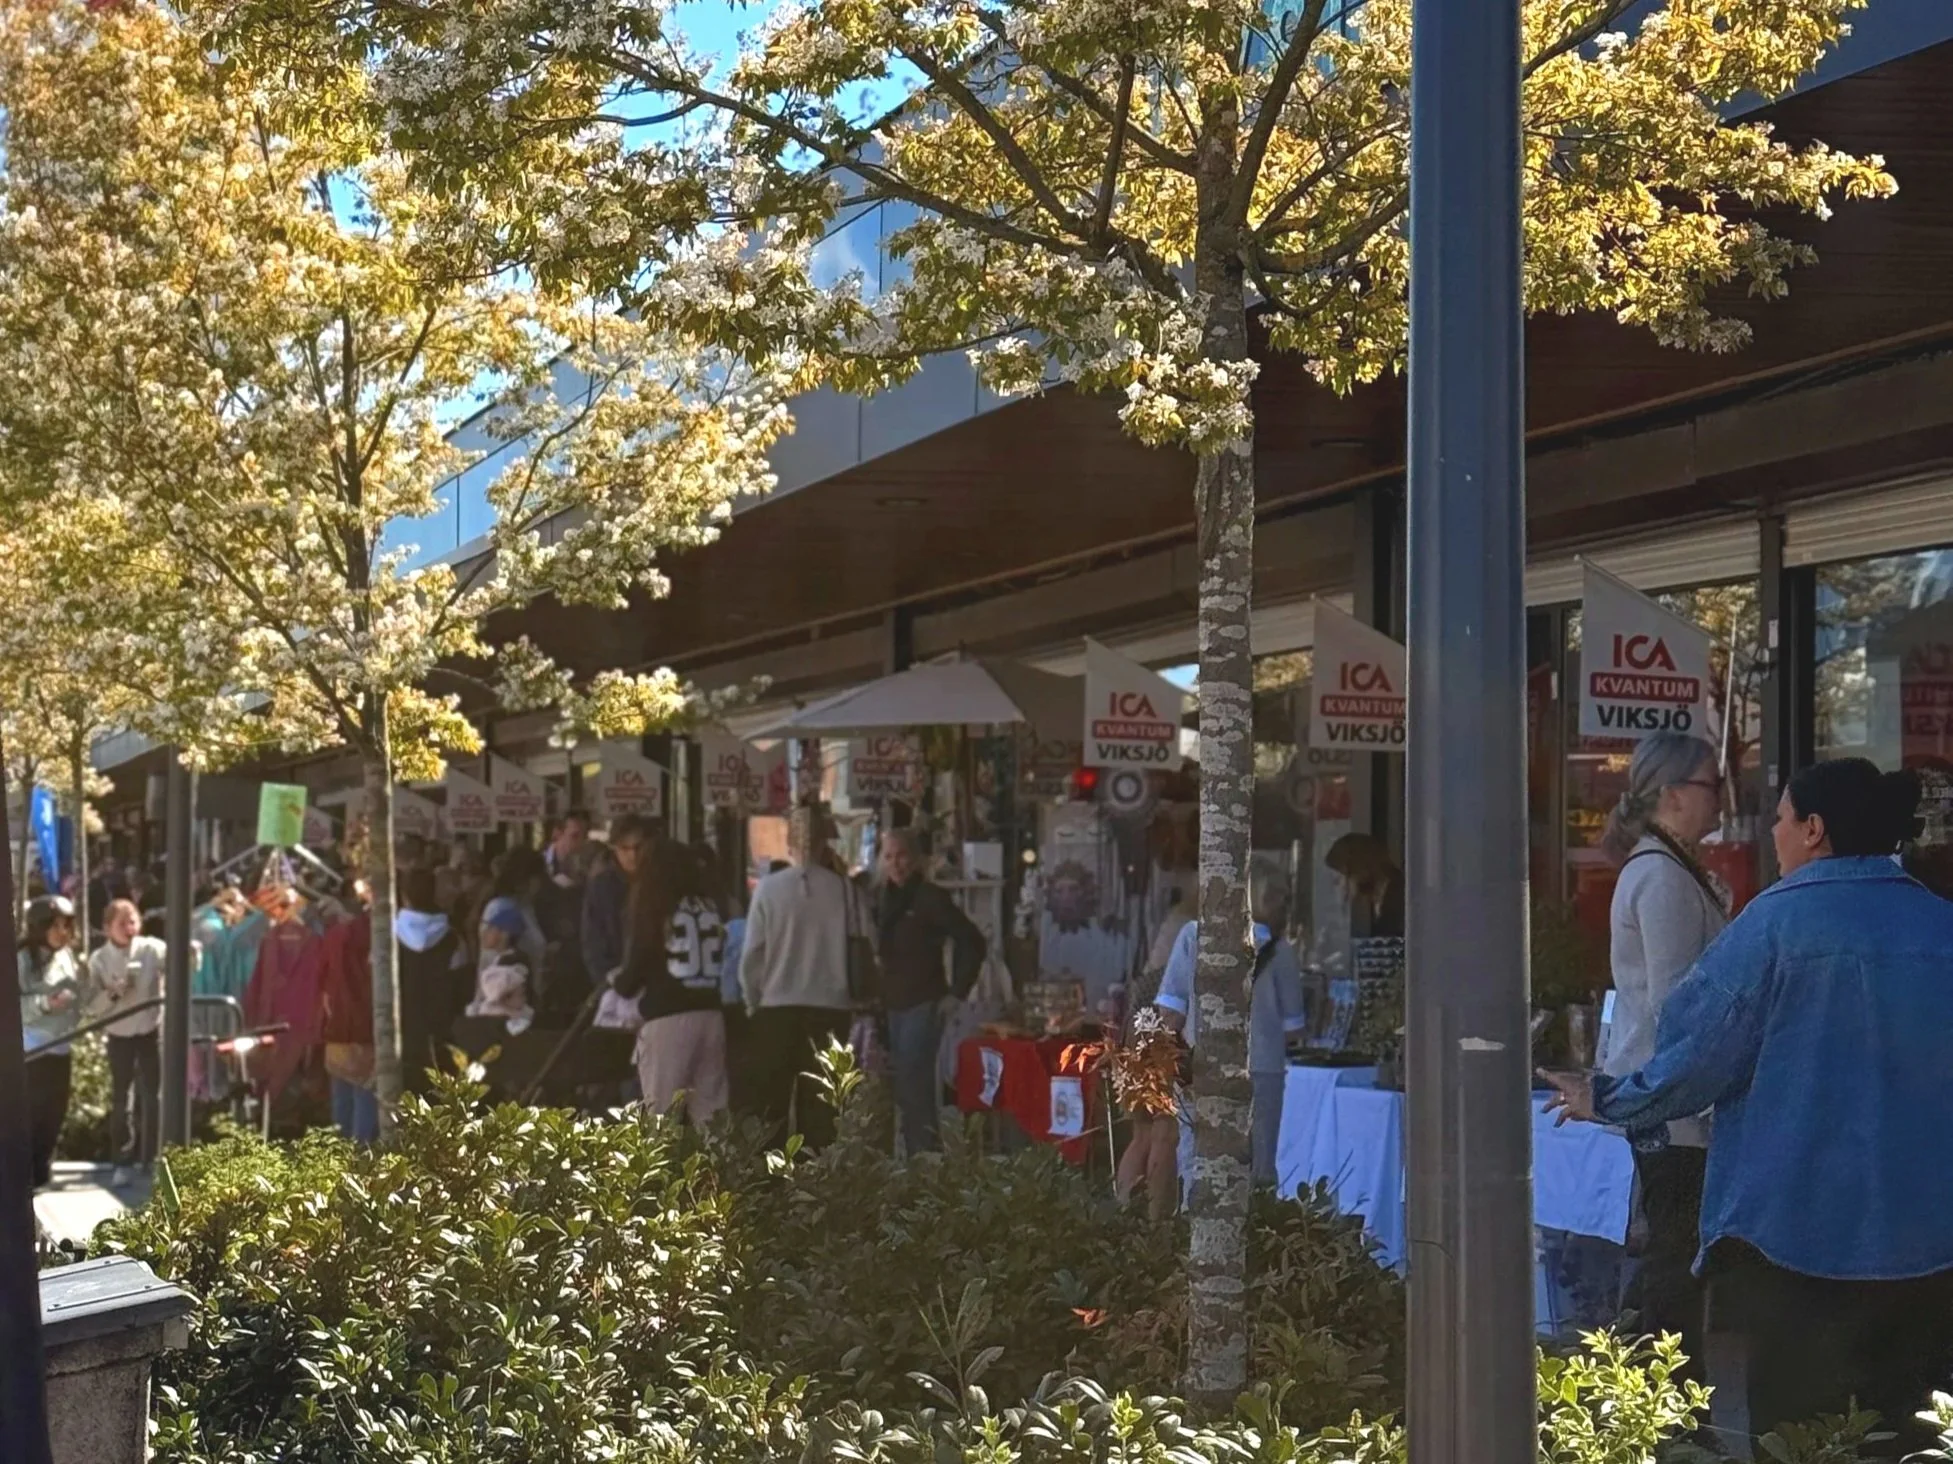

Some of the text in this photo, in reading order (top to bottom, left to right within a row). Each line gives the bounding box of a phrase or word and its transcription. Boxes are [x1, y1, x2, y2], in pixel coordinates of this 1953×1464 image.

[1613, 633, 1677, 671] ICA
[1340, 662, 1393, 692] ICA
[1594, 676, 1694, 698] KVANTUM
[1109, 691, 1157, 718] ICA
[1324, 697, 1405, 715] KVANTUM
[1595, 703, 1693, 731] VIKSJÖ
[1095, 723, 1171, 738] KVANTUM
[1325, 720, 1406, 744] VIKSJÖ
[1096, 742, 1169, 762] VIKSJÖ
[615, 769, 645, 786] ICA
